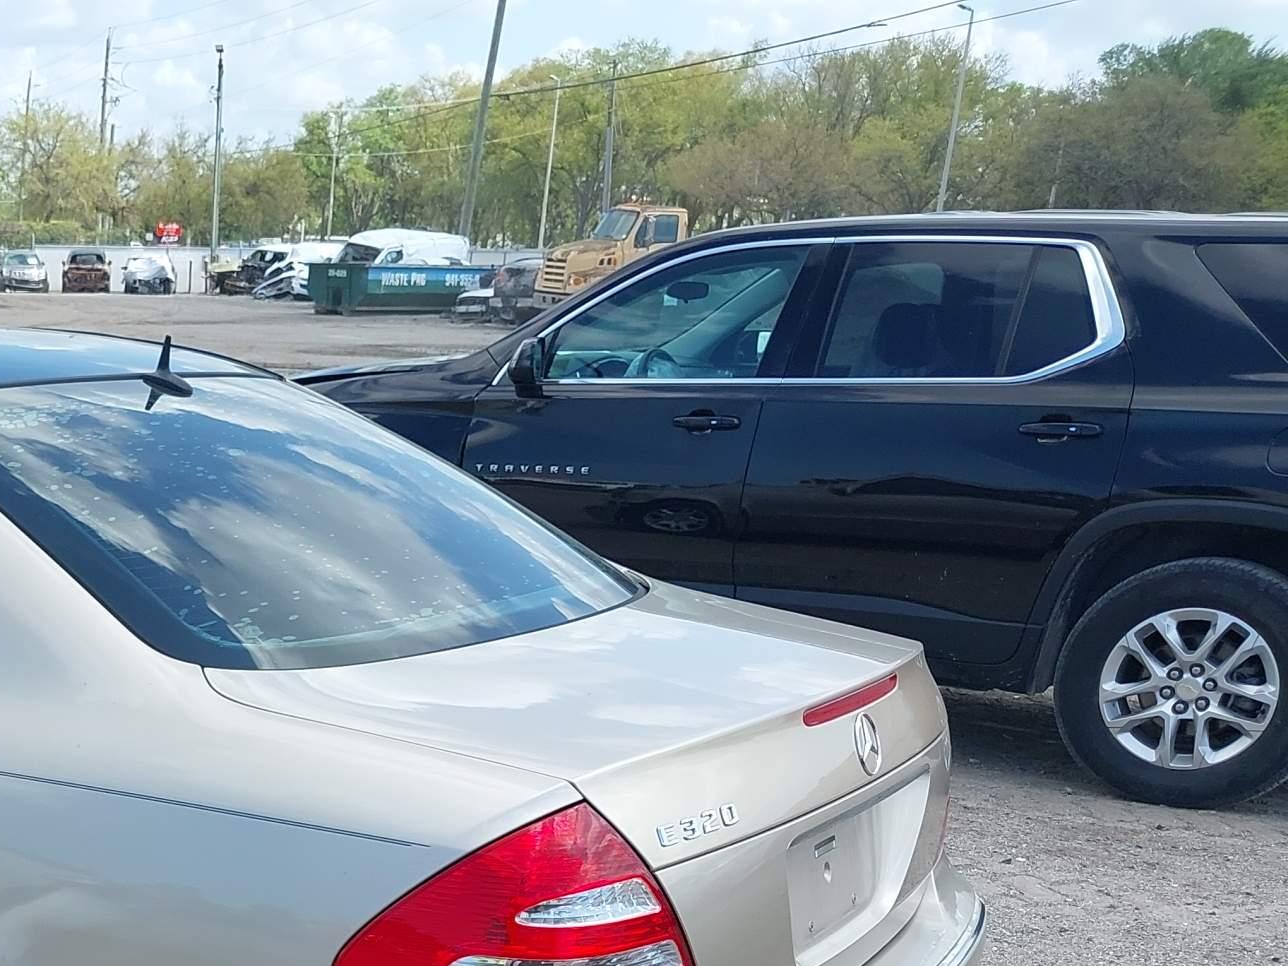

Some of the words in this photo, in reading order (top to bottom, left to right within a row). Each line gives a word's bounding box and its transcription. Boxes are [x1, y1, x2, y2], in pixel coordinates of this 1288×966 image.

[381, 272, 409, 287] WASTE
[475, 463, 592, 475] TRAVERSE
[656, 802, 740, 848] E320
